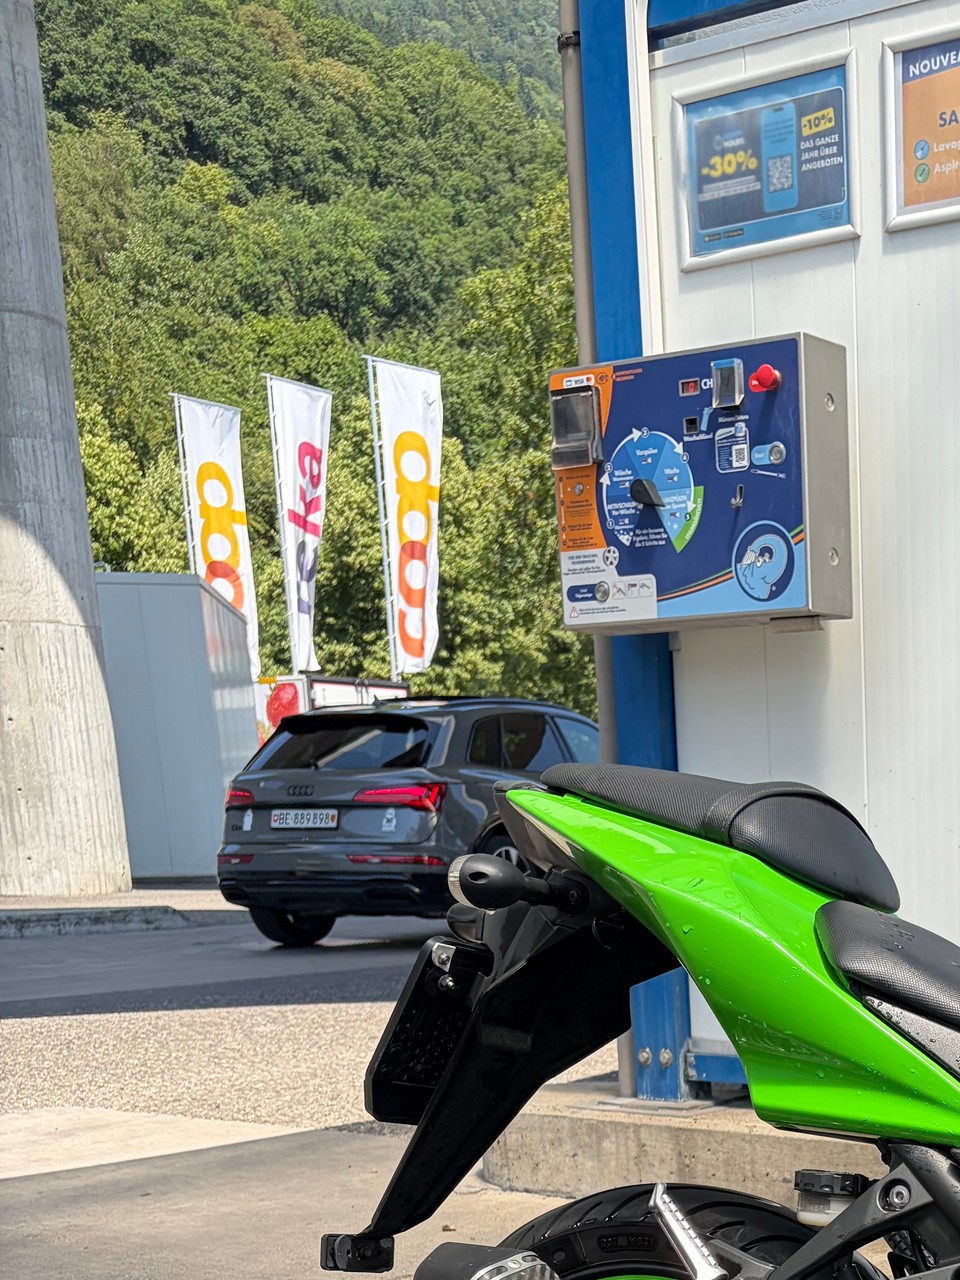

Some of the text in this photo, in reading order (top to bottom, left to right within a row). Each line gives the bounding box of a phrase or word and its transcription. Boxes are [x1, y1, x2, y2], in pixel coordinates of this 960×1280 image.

[802, 112, 833, 131] -10%
[800, 134, 839, 150] DAS GANZE
[701, 148, 758, 178] -30%
[801, 146, 838, 161] JAHR ÜBER
[801, 156, 844, 172] ANGEBOTEN
[196, 461, 248, 612] oop
[393, 430, 440, 659] coop
